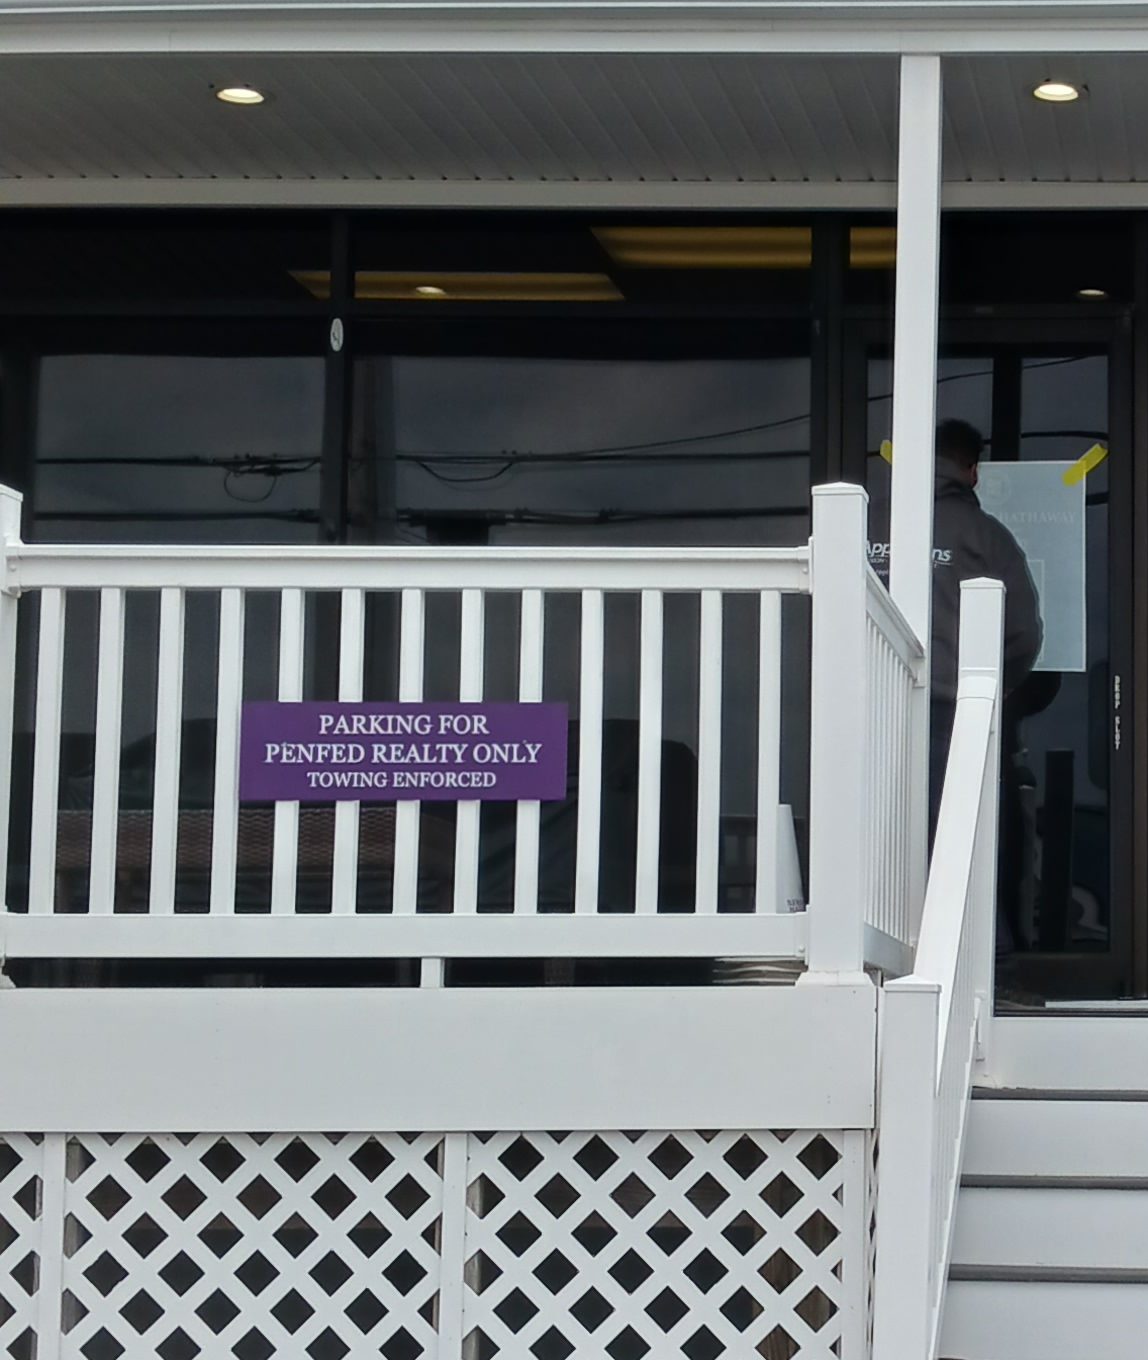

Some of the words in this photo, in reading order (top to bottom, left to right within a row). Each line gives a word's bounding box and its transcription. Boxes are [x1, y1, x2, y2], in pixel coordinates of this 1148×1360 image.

[318, 714, 433, 736] PARKING
[438, 714, 490, 735] FOR
[263, 742, 366, 764] PENFED
[371, 742, 468, 764] REALTY
[472, 742, 542, 764] ONLY
[306, 771, 388, 789] TOWING
[392, 771, 497, 789] ENFORCED
